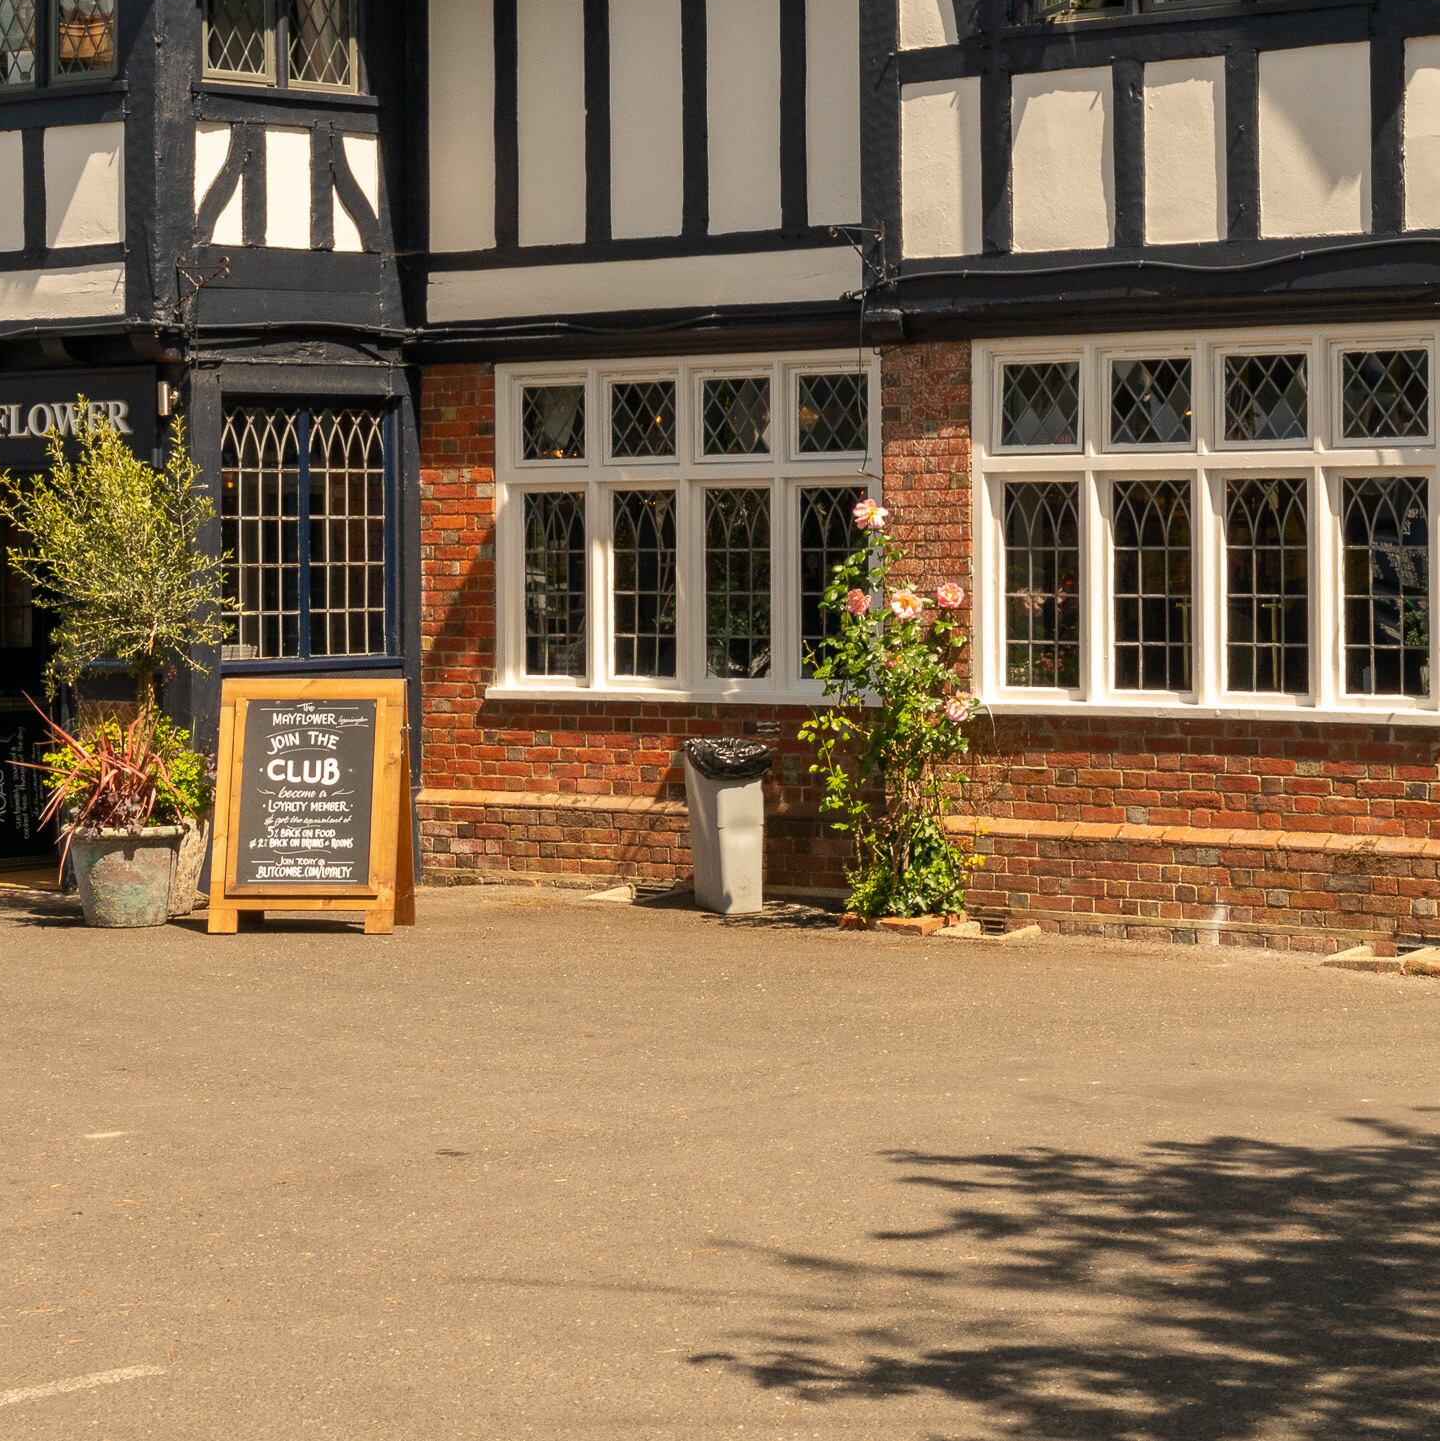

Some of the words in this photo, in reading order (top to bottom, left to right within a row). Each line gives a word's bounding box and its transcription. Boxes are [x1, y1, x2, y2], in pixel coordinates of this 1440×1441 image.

[296, 702, 316, 712] The
[272, 712, 338, 726] MAYFLOWER
[267, 732, 300, 755] JOIN
[307, 731, 340, 750] THE
[266, 757, 341, 786] CLUB
[278, 786, 317, 798] become
[318, 790, 328, 798] a
[268, 799, 308, 813] LOYALTY
[310, 801, 350, 812] MEMBER
[274, 815, 290, 826] get
[289, 815, 303, 823] the
[280, 828, 302, 838] BACK
[301, 829, 313, 838] ON
[315, 829, 336, 838] FOOD
[269, 838, 289, 848] BACK
[289, 838, 300, 847] ON
[331, 838, 354, 849] ROOMS
[276, 856, 294, 866] JOIN
[295, 857, 318, 866] TODAY
